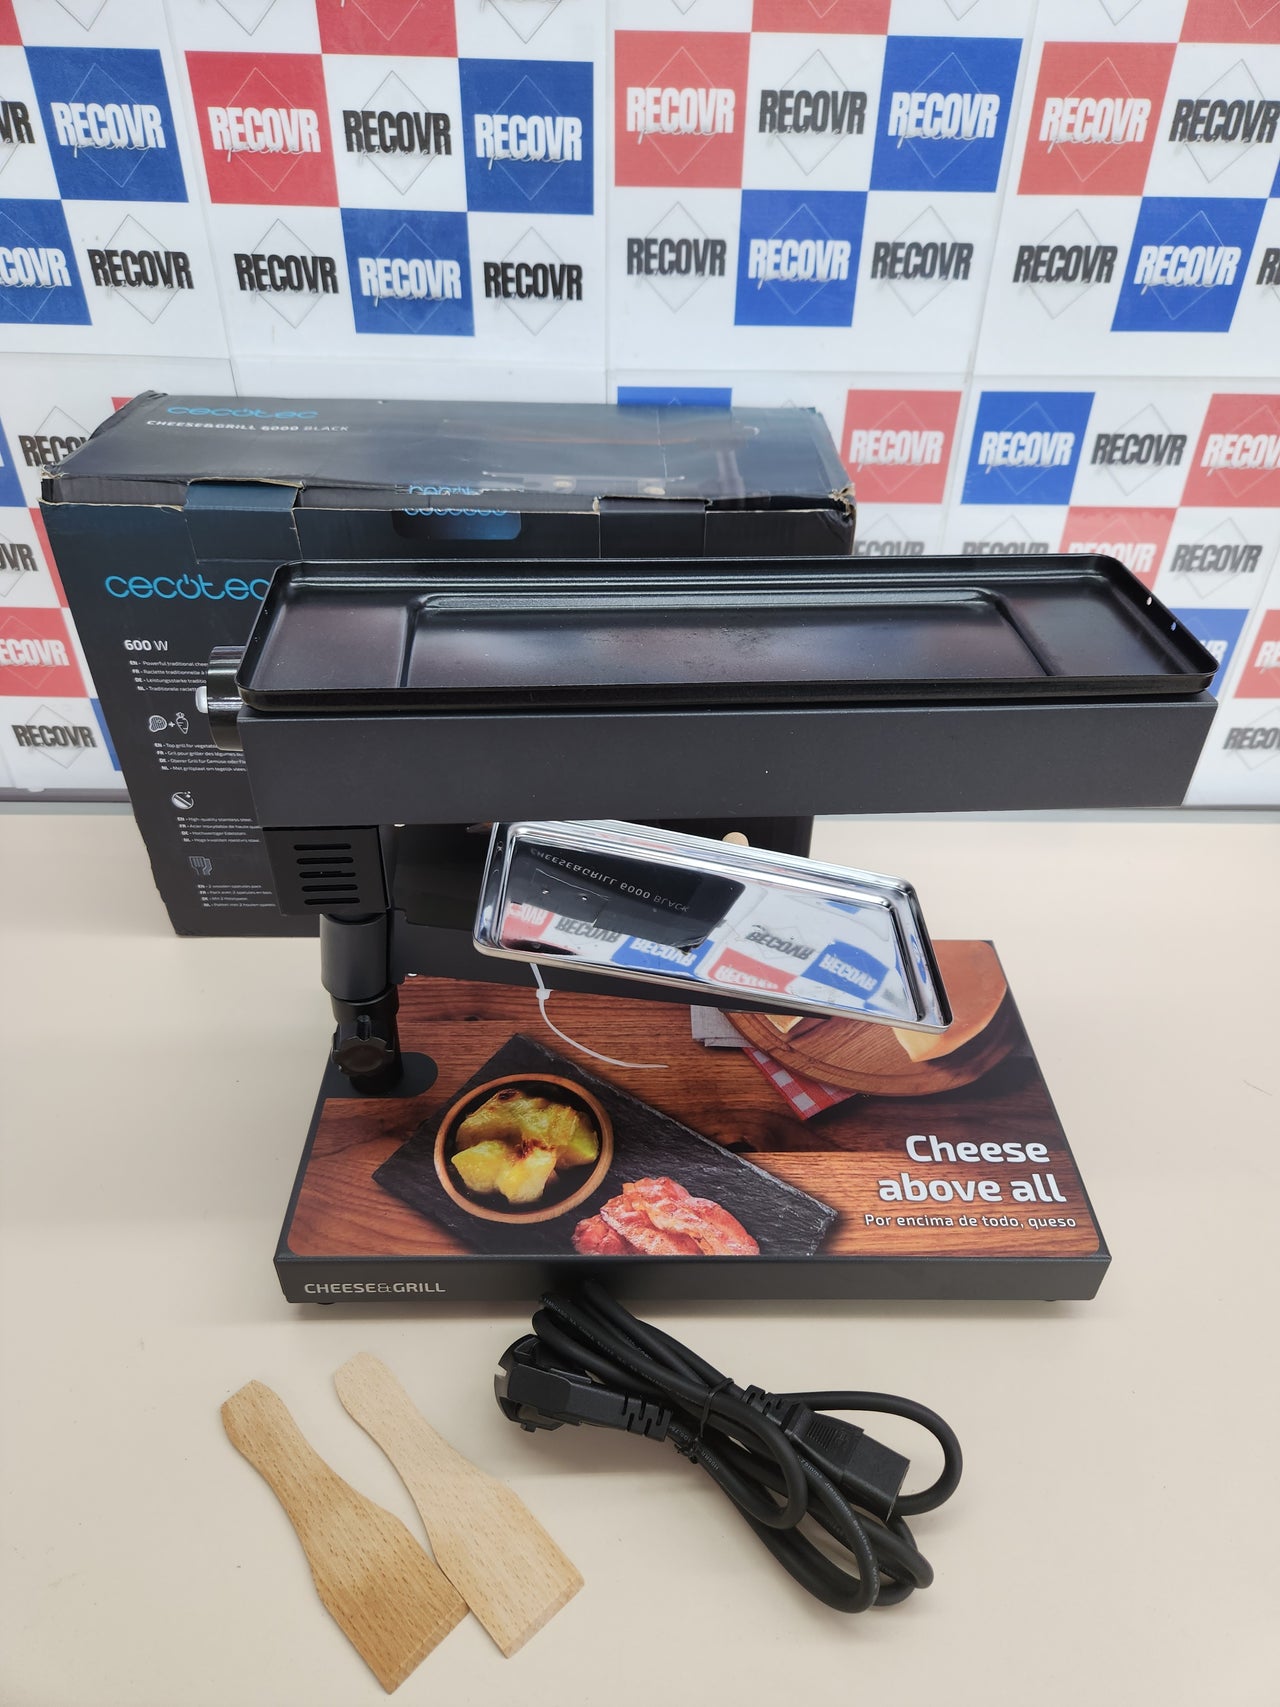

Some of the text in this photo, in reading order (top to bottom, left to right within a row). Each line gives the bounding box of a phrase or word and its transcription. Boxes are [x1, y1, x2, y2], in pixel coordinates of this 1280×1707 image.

[51, 102, 166, 148] RECOVR
[208, 106, 321, 153] RECOVR
[627, 87, 735, 133] RECOVR
[759, 90, 867, 134] RECOVR
[888, 92, 999, 138] RECOVR
[1039, 97, 1151, 142] RECOVR
[1169, 99, 1280, 143] RECOVR
[343, 110, 452, 155] RECOVR
[474, 114, 582, 161] RECOVR
[87, 249, 194, 289] RECOVR
[234, 253, 339, 294] RECOVR
[627, 238, 726, 276] RECOVR
[749, 239, 851, 280] RECOVR
[871, 242, 974, 281] RECOVR
[1012, 245, 1118, 284] RECOVR
[1134, 246, 1241, 286] RECOVR
[358, 257, 462, 300] RECOVR
[483, 262, 583, 301] RECOVR
[146, 419, 350, 433] CHEESE&GRILL 6000 BLACK
[167, 405, 320, 420] cecotec
[18, 435, 88, 467] RECO
[849, 429, 945, 465] RECOVR
[978, 431, 1076, 466] RECOVR
[1090, 433, 1187, 467] RECOVR
[1170, 545, 1263, 573] RECOVR
[124, 639, 169, 652] 600 W
[12, 725, 97, 748] RECOVR
[905, 1134, 1051, 1164] Cheese
[878, 1173, 1067, 1203] above all
[864, 1214, 1076, 1229] Por encima de todo, queso
[304, 1282, 447, 1294] CHEESE&GRILL
